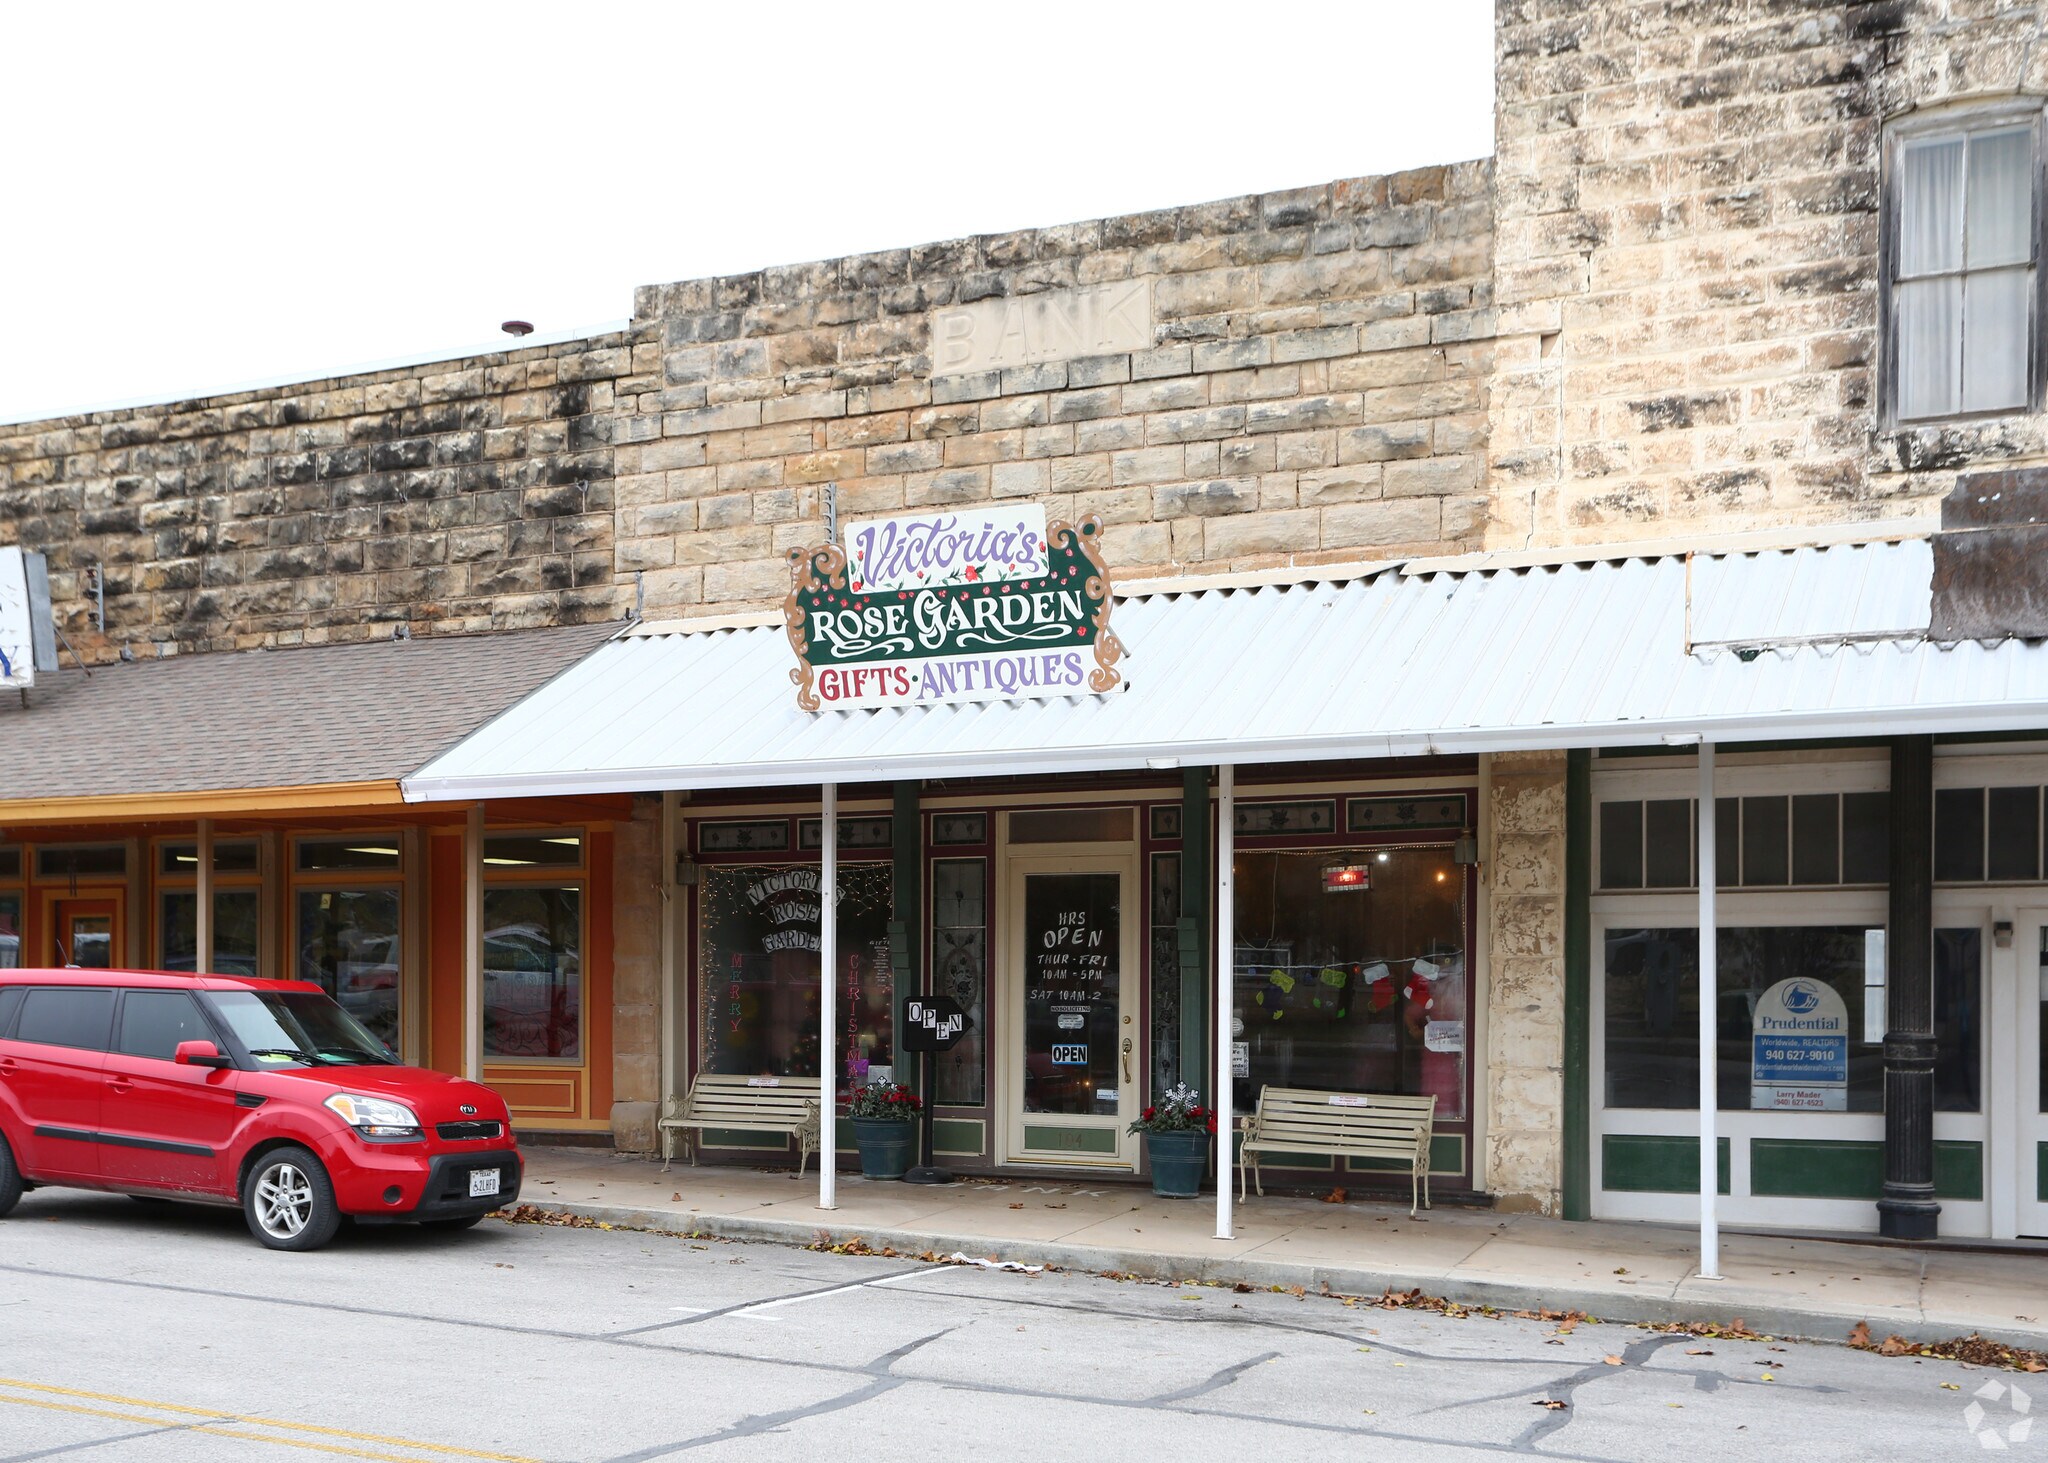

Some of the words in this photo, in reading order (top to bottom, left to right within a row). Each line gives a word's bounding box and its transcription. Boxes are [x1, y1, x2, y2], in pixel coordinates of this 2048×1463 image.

[938, 282, 1146, 372] BANK
[856, 515, 1040, 586] Victoria's
[810, 604, 914, 657] ROSE
[913, 589, 1085, 649] GARDEN
[818, 666, 911, 701] GIFTS
[916, 652, 1084, 700] ANTIQUES
[773, 902, 820, 923] ROSE
[1059, 912, 1085, 925] HRS
[763, 930, 822, 952] GARDE
[1044, 927, 1102, 948] OPEN
[1038, 954, 1069, 965] THUR
[1080, 954, 1107, 967] FRI
[1042, 969, 1067, 980] 10AM
[1081, 969, 1102, 980] 5PM
[729, 953, 743, 1032] MERRY
[1030, 990, 1053, 1000] SAT
[909, 1003, 961, 1039] OPEN
[1762, 1016, 1839, 1030] Prudential
[1761, 1038, 1800, 1047] Worldwide,
[1053, 1046, 1087, 1062] OPEN
[1765, 1050, 1784, 1061] 940
[1786, 1050, 1834, 1061] 627-9010
[1776, 1091, 1795, 1099] Larry
